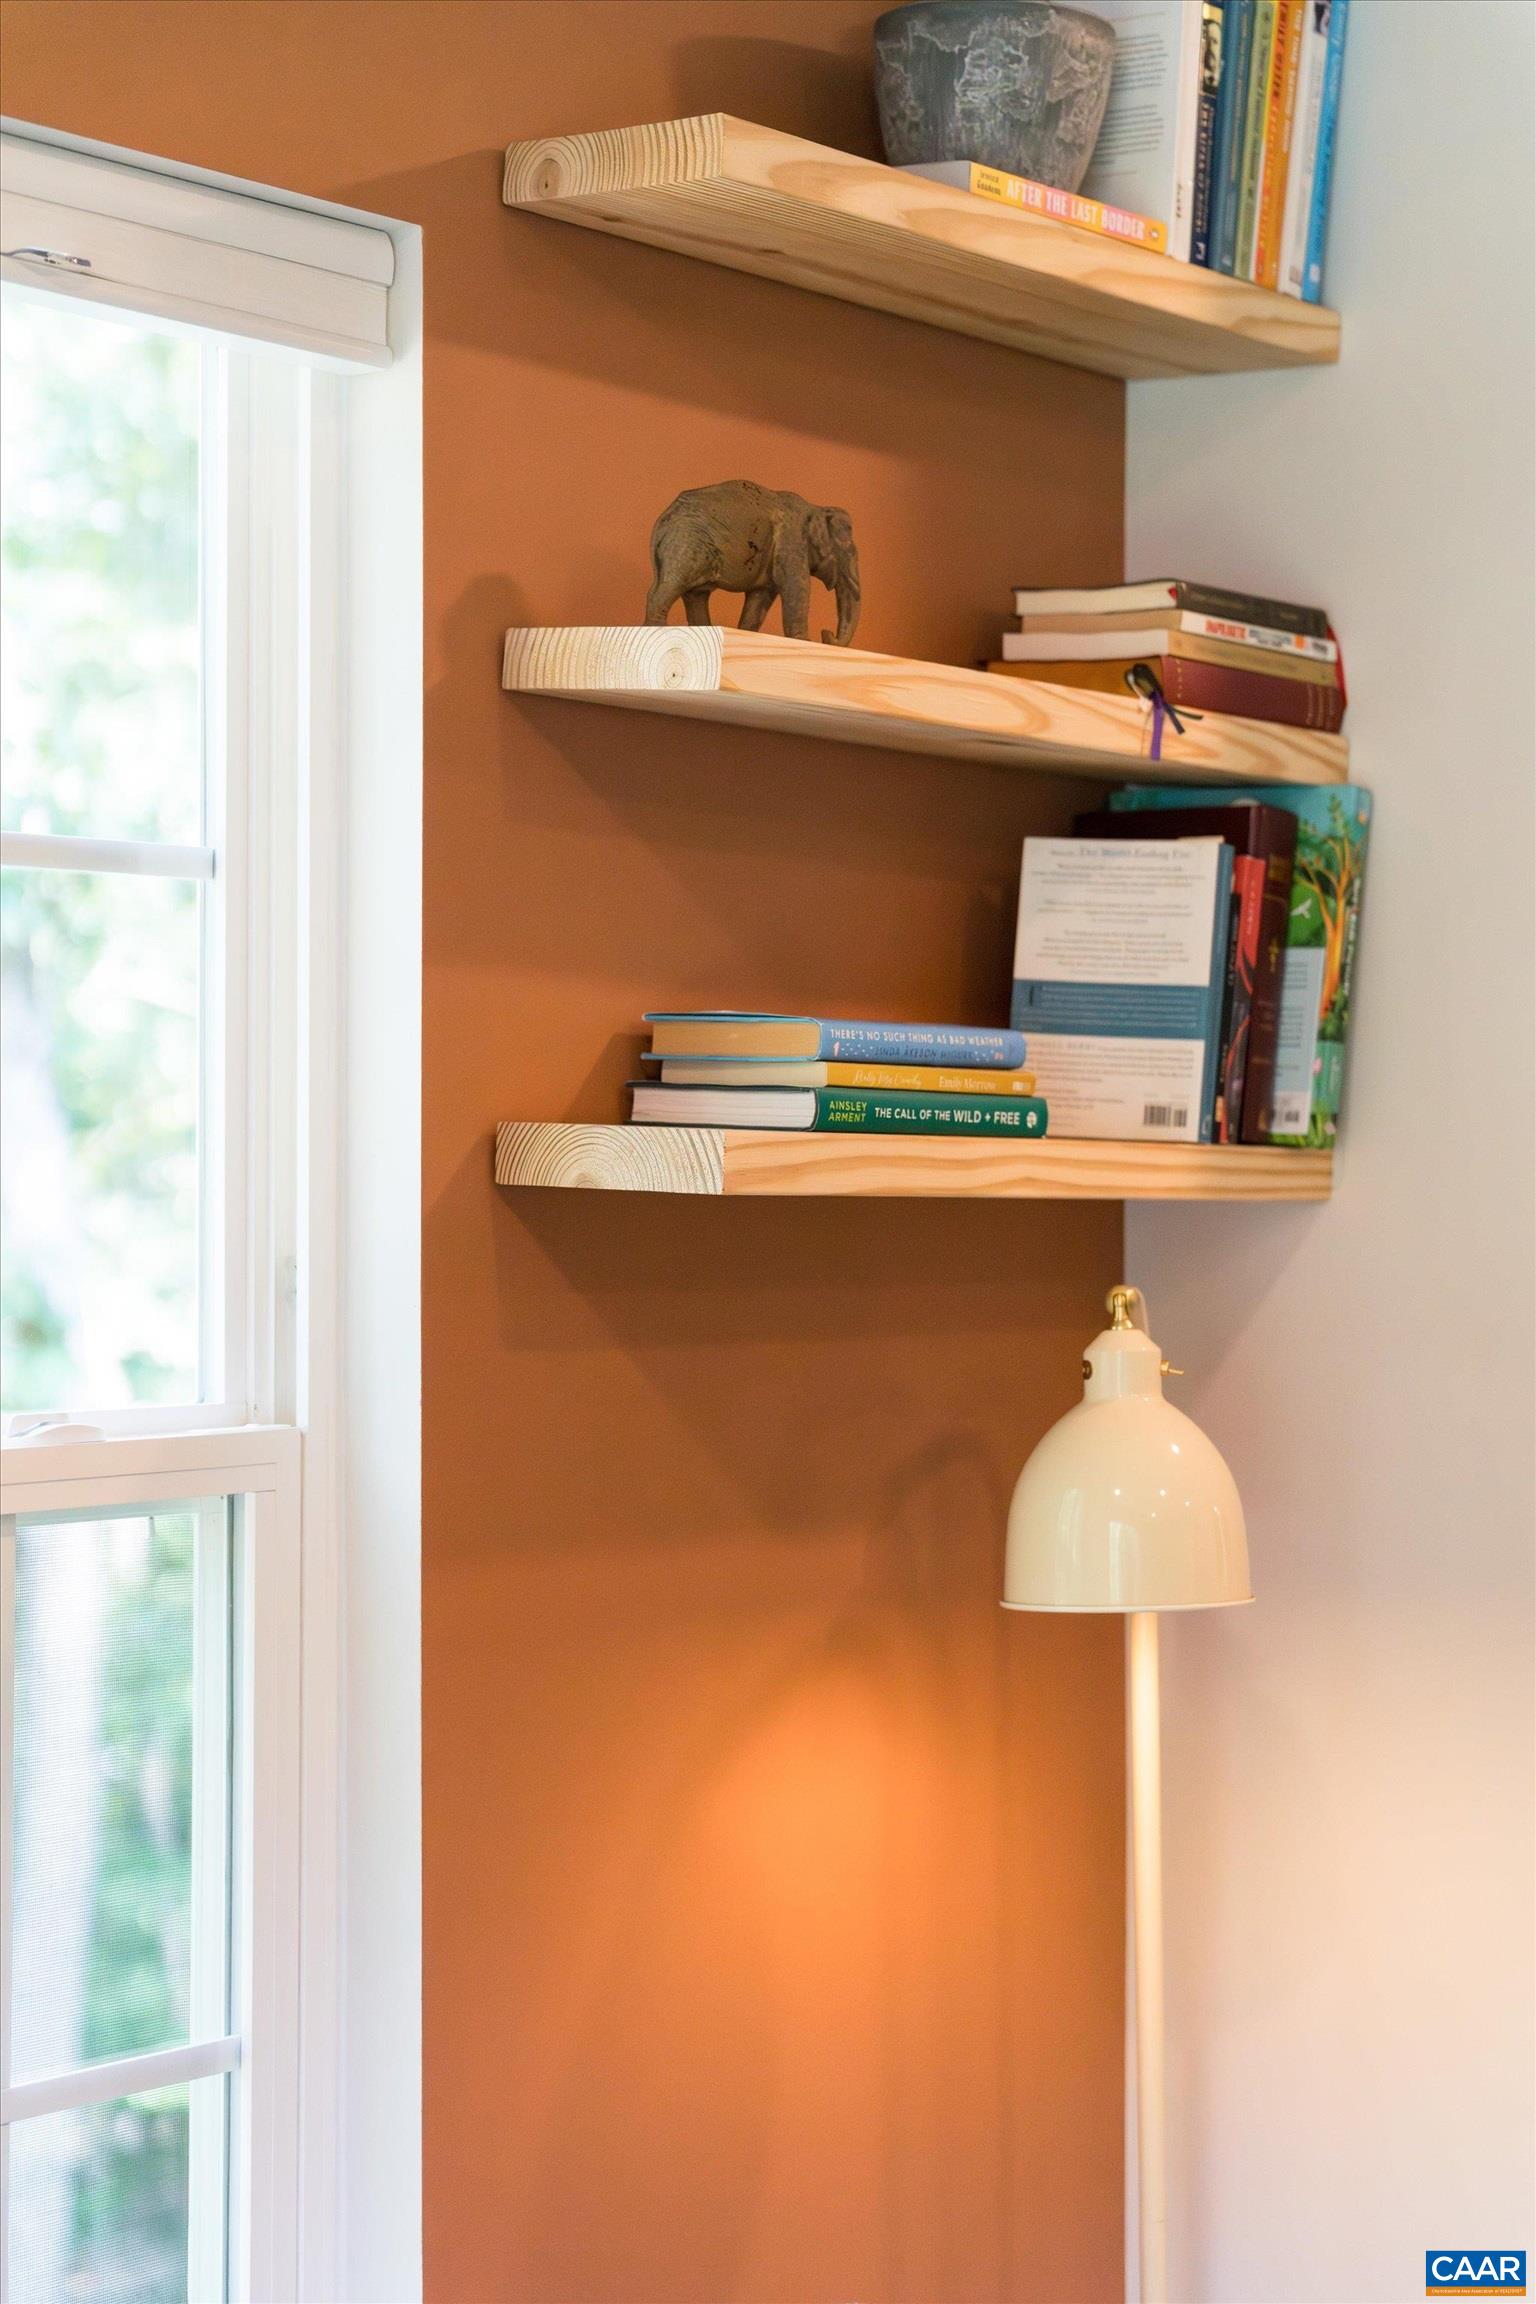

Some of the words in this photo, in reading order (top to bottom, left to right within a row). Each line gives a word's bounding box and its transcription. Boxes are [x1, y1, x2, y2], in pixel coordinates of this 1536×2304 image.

[1006, 178, 1043, 209] AFTER
[1046, 190, 1067, 217] THE
[1071, 199, 1098, 225] LAST
[1101, 208, 1146, 241] BORDER
[831, 1028, 864, 1041] THERE'S
[866, 1031, 881, 1041] NO
[883, 1031, 906, 1042] SUCH
[908, 1032, 934, 1044] THING
[936, 1034, 947, 1045] AS
[949, 1035, 966, 1046] BAD
[967, 1036, 1004, 1048] WEATHER
[829, 1101, 868, 1112] AINSLEY
[828, 1112, 867, 1123] ARMENT
[874, 1107, 893, 1119] THE
[894, 1108, 917, 1120] CALL
[919, 1110, 932, 1120] OF
[934, 1110, 951, 1121] THE
[953, 1110, 982, 1123] WILD
[993, 1111, 1021, 1126] FREE
